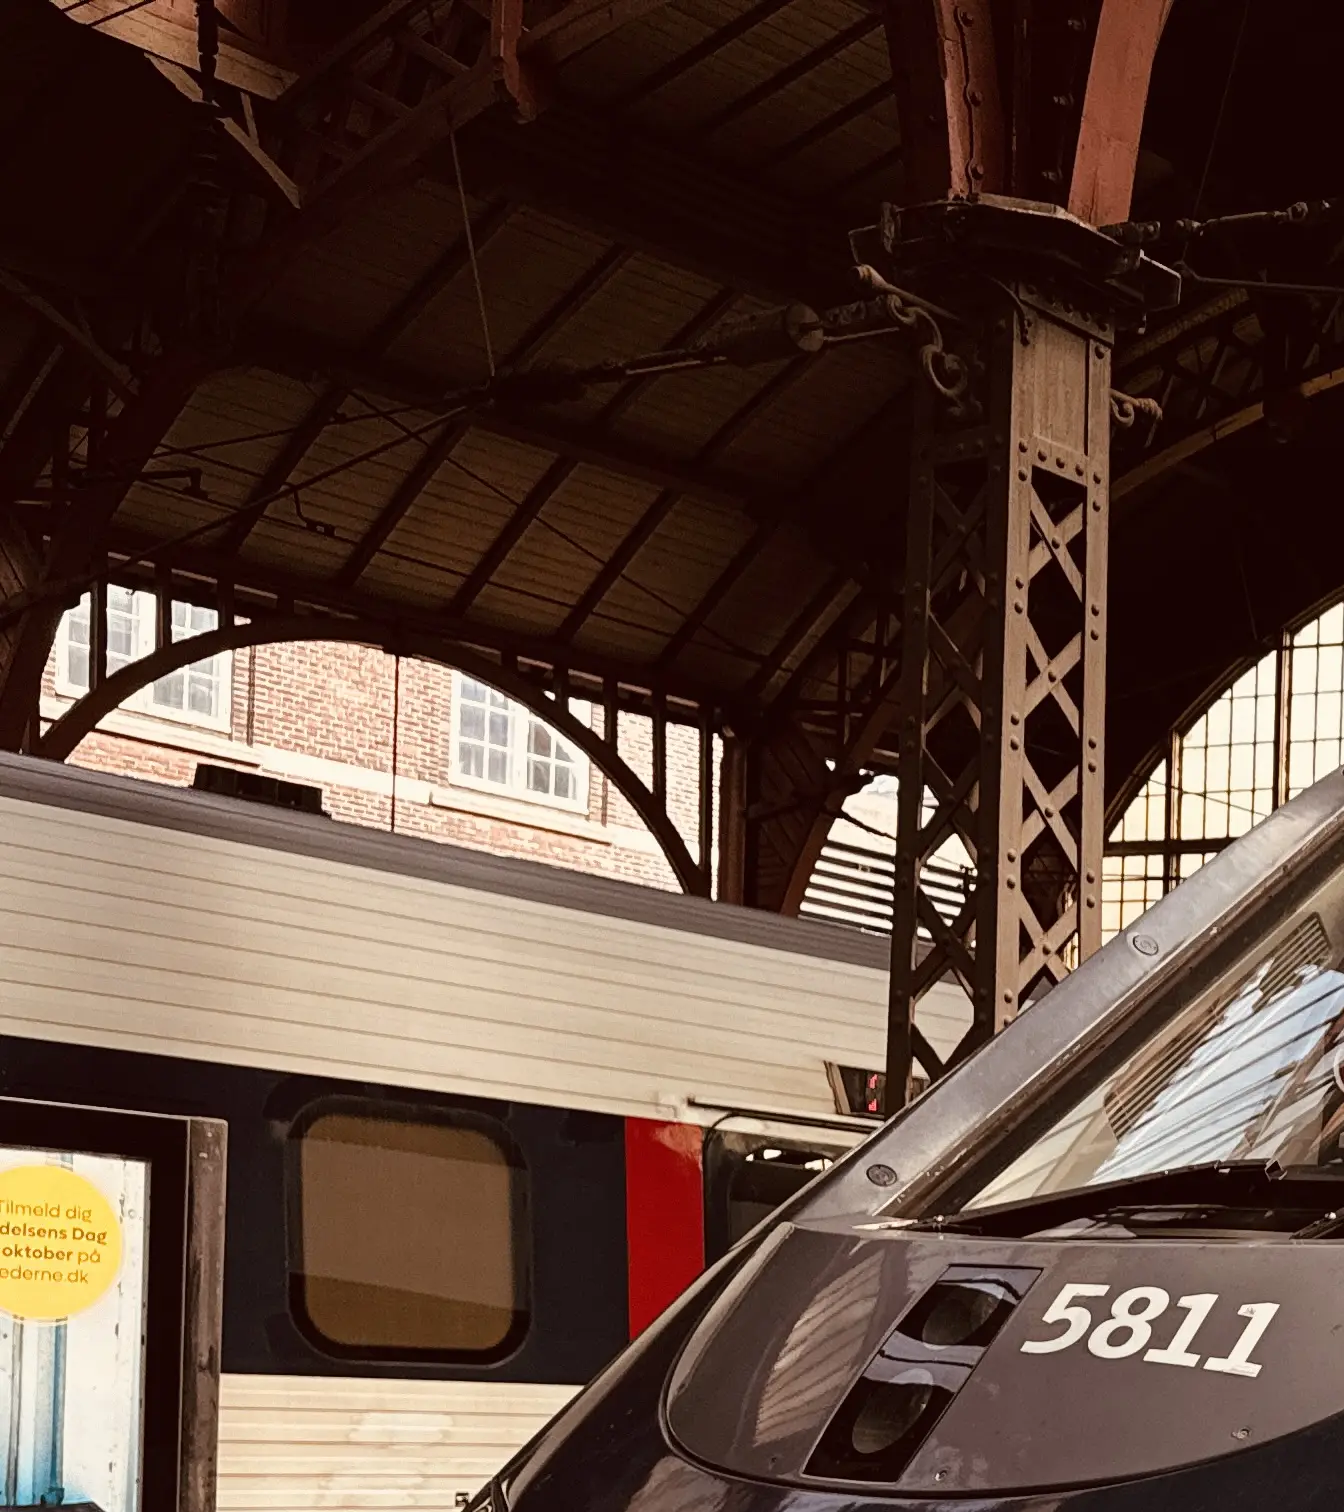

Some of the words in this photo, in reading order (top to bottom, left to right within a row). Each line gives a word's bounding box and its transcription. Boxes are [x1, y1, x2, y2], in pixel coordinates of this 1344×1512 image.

[65, 1204, 93, 1223] dig
[0, 1221, 68, 1240] delsens
[72, 1227, 108, 1246] Dag
[2, 1244, 74, 1262] oktober
[77, 1247, 101, 1266] på
[1020, 1283, 1281, 1378] 5811
